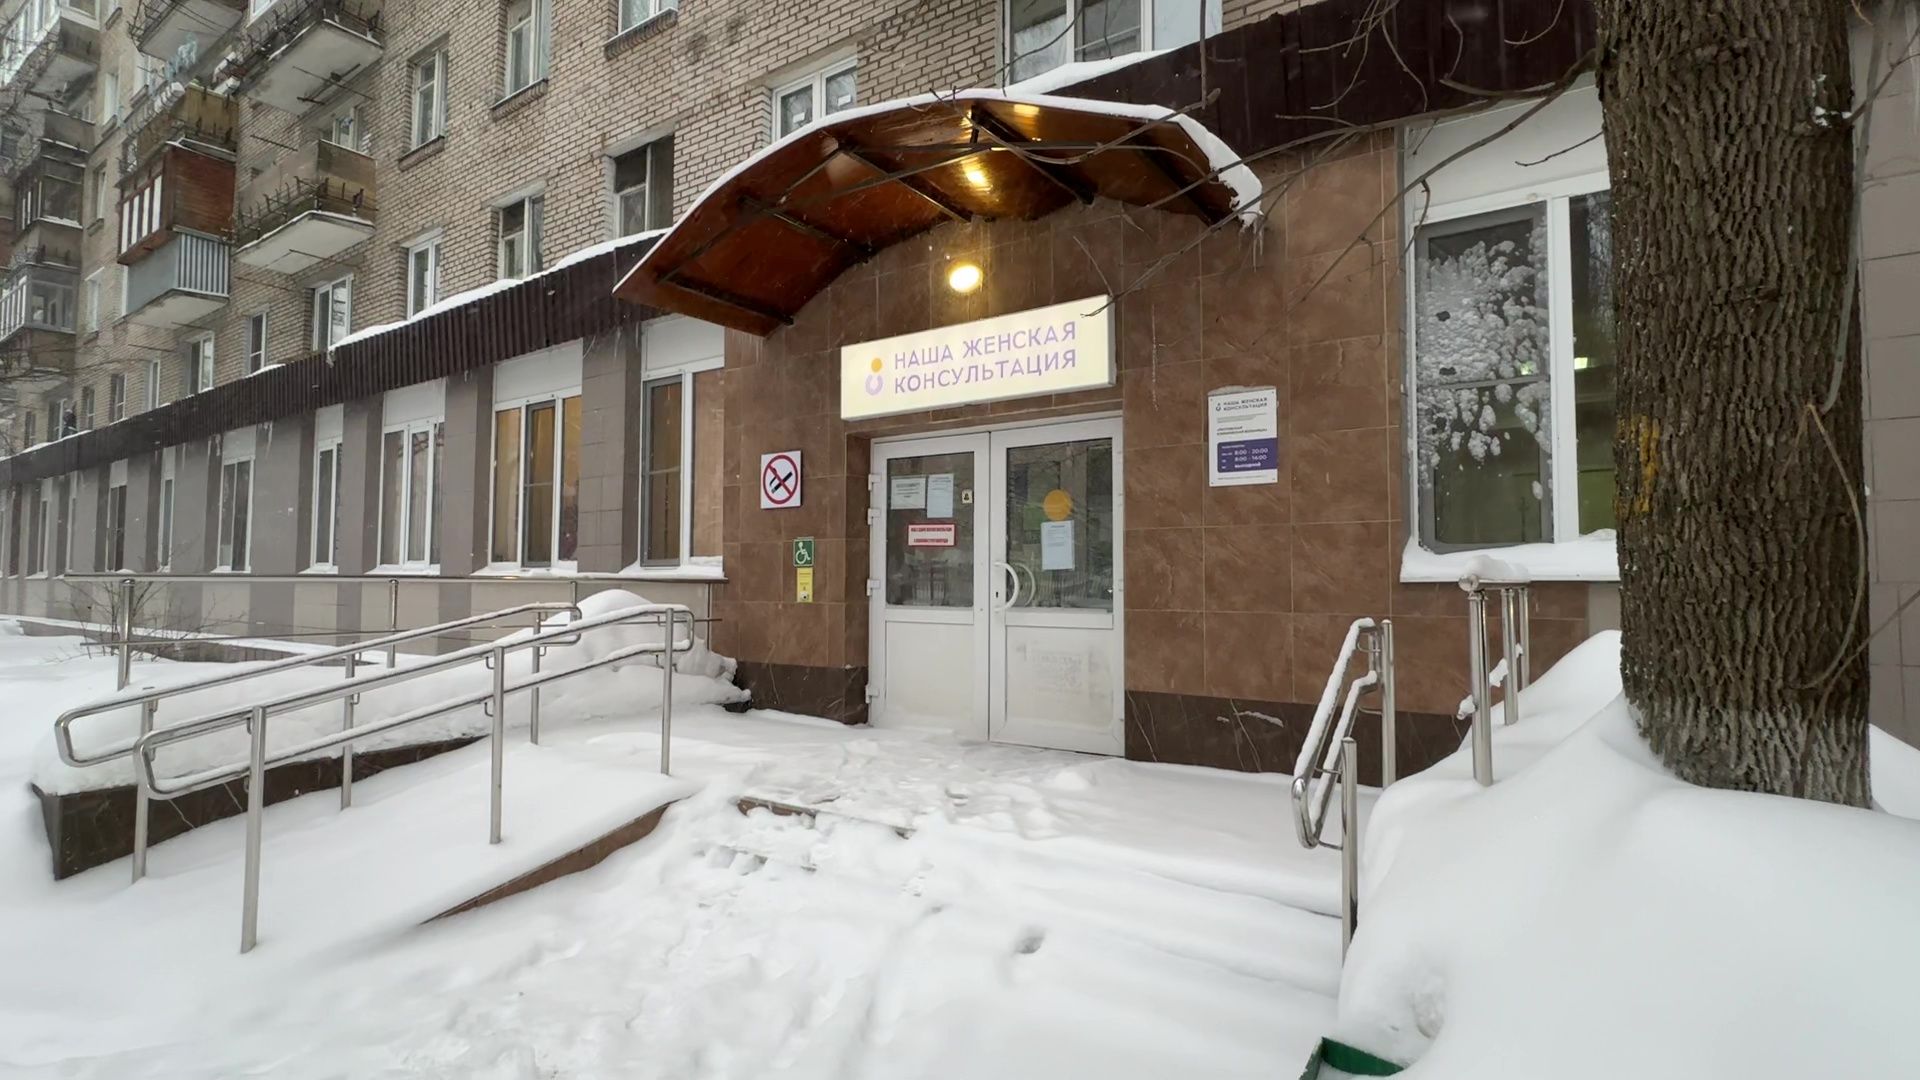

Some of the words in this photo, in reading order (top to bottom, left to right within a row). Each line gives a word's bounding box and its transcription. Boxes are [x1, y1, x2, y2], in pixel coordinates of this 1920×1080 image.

[895, 344, 953, 370] НАША
[962, 321, 1076, 359] ЖЕНСКАЯ
[894, 349, 1076, 394] КОНСУЛЬТАЦИЯ
[1223, 403, 1267, 411] КОНСУЛЬТАЦИЯ
